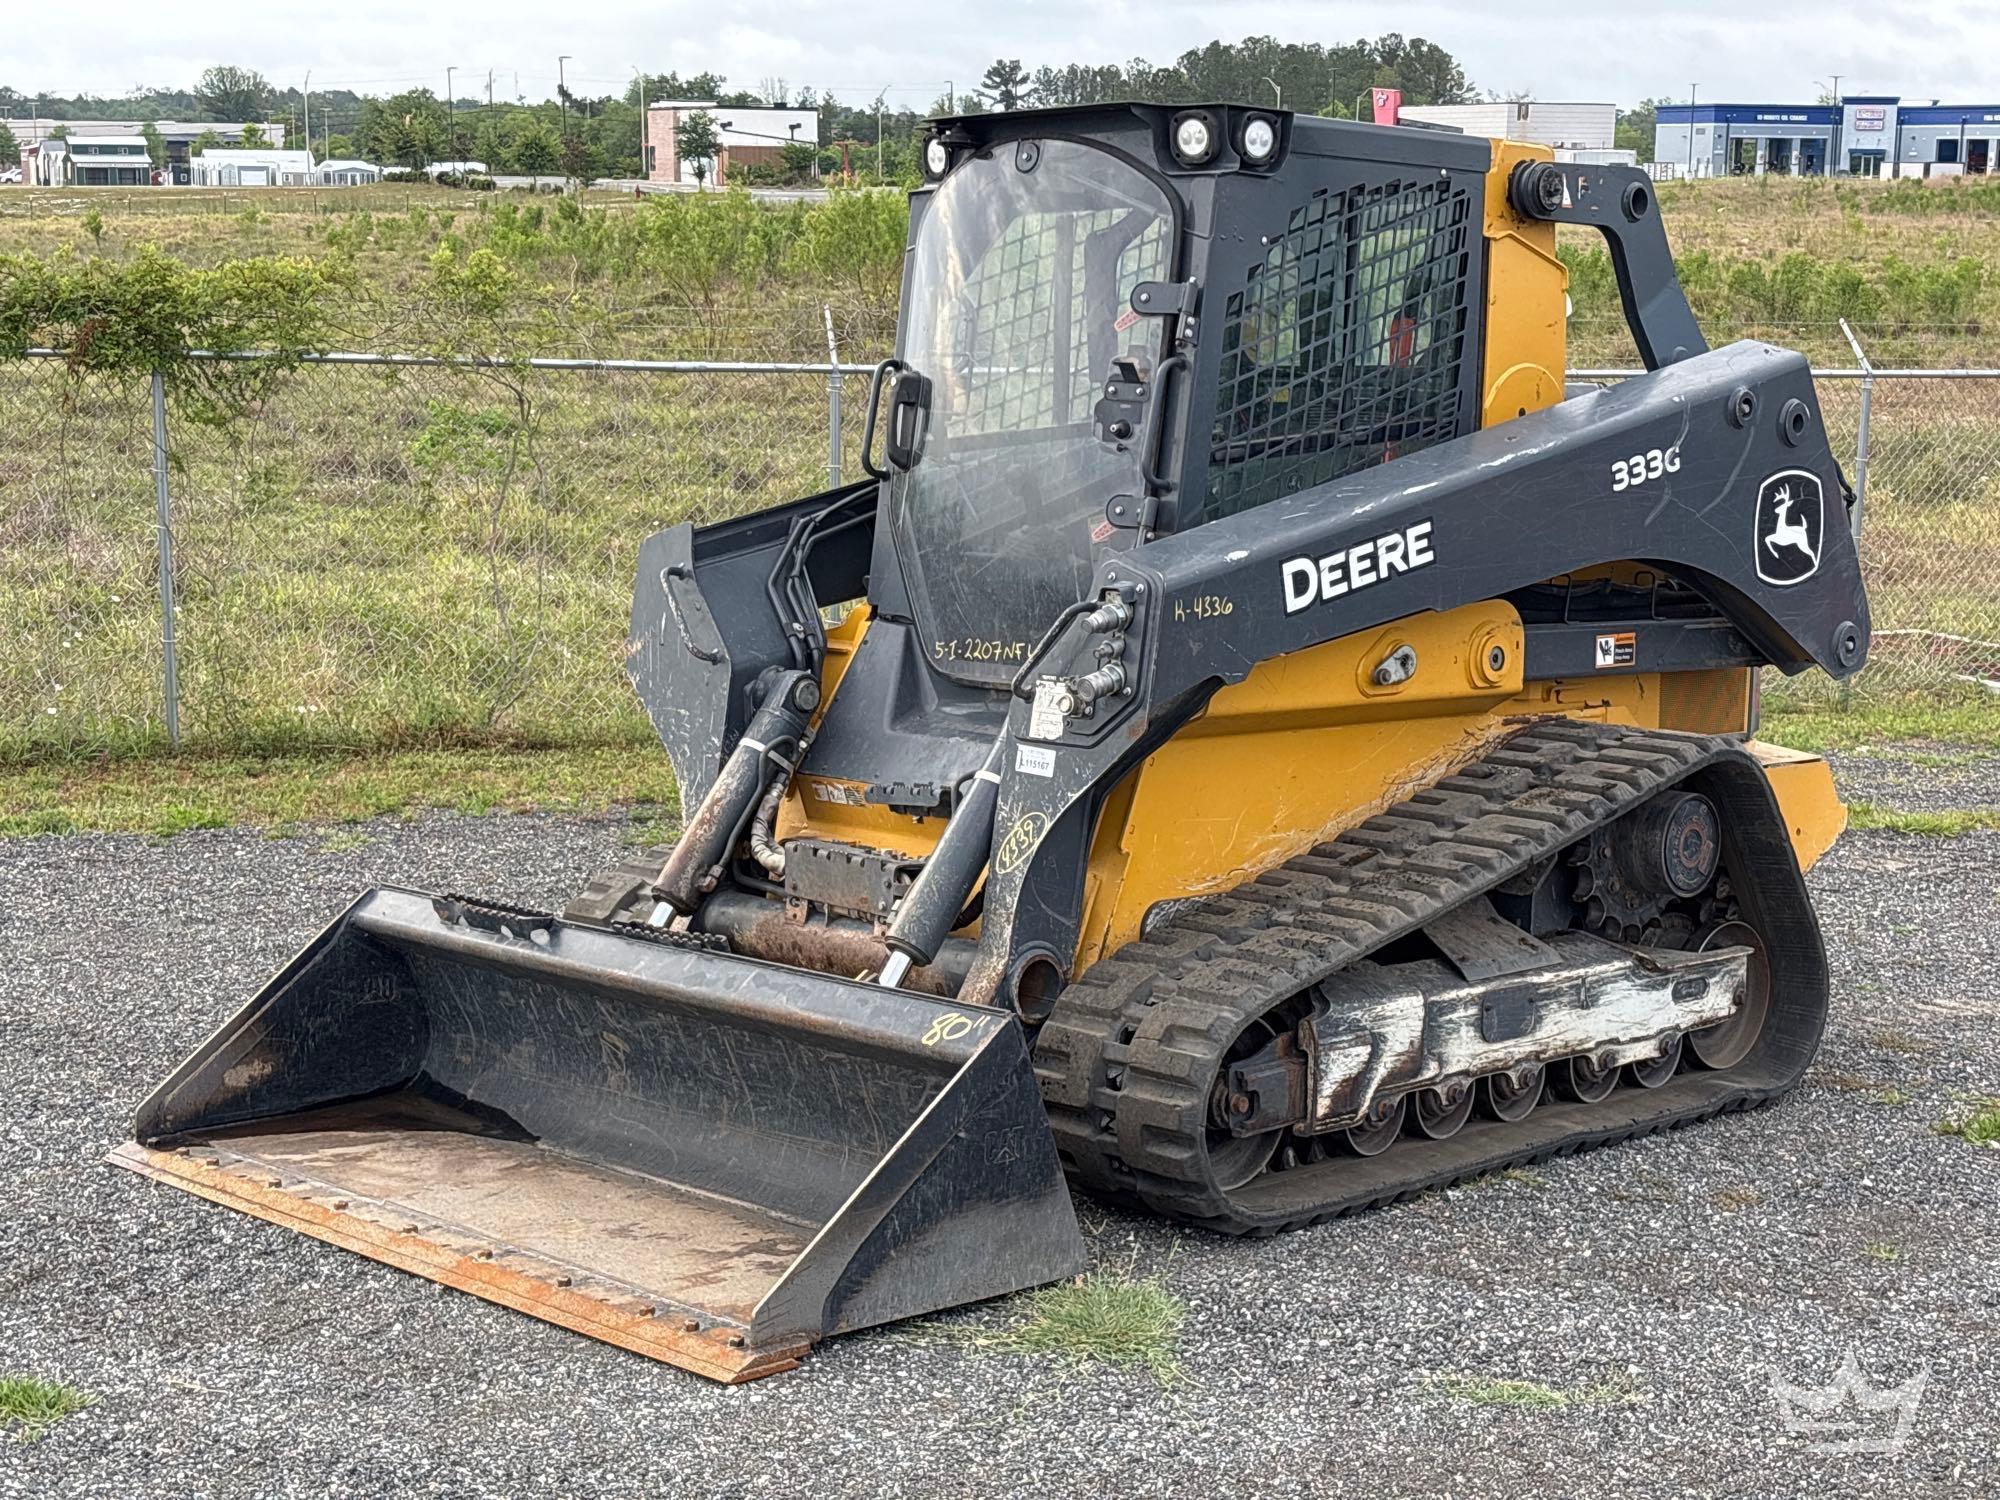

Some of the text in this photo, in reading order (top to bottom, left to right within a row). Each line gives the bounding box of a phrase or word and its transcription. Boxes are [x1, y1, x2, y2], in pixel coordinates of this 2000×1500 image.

[1611, 447, 1681, 492] 333G
[1282, 521, 1434, 613] DEERE
[1001, 819, 1034, 868] 4339
[921, 1012, 991, 1047] 80"
